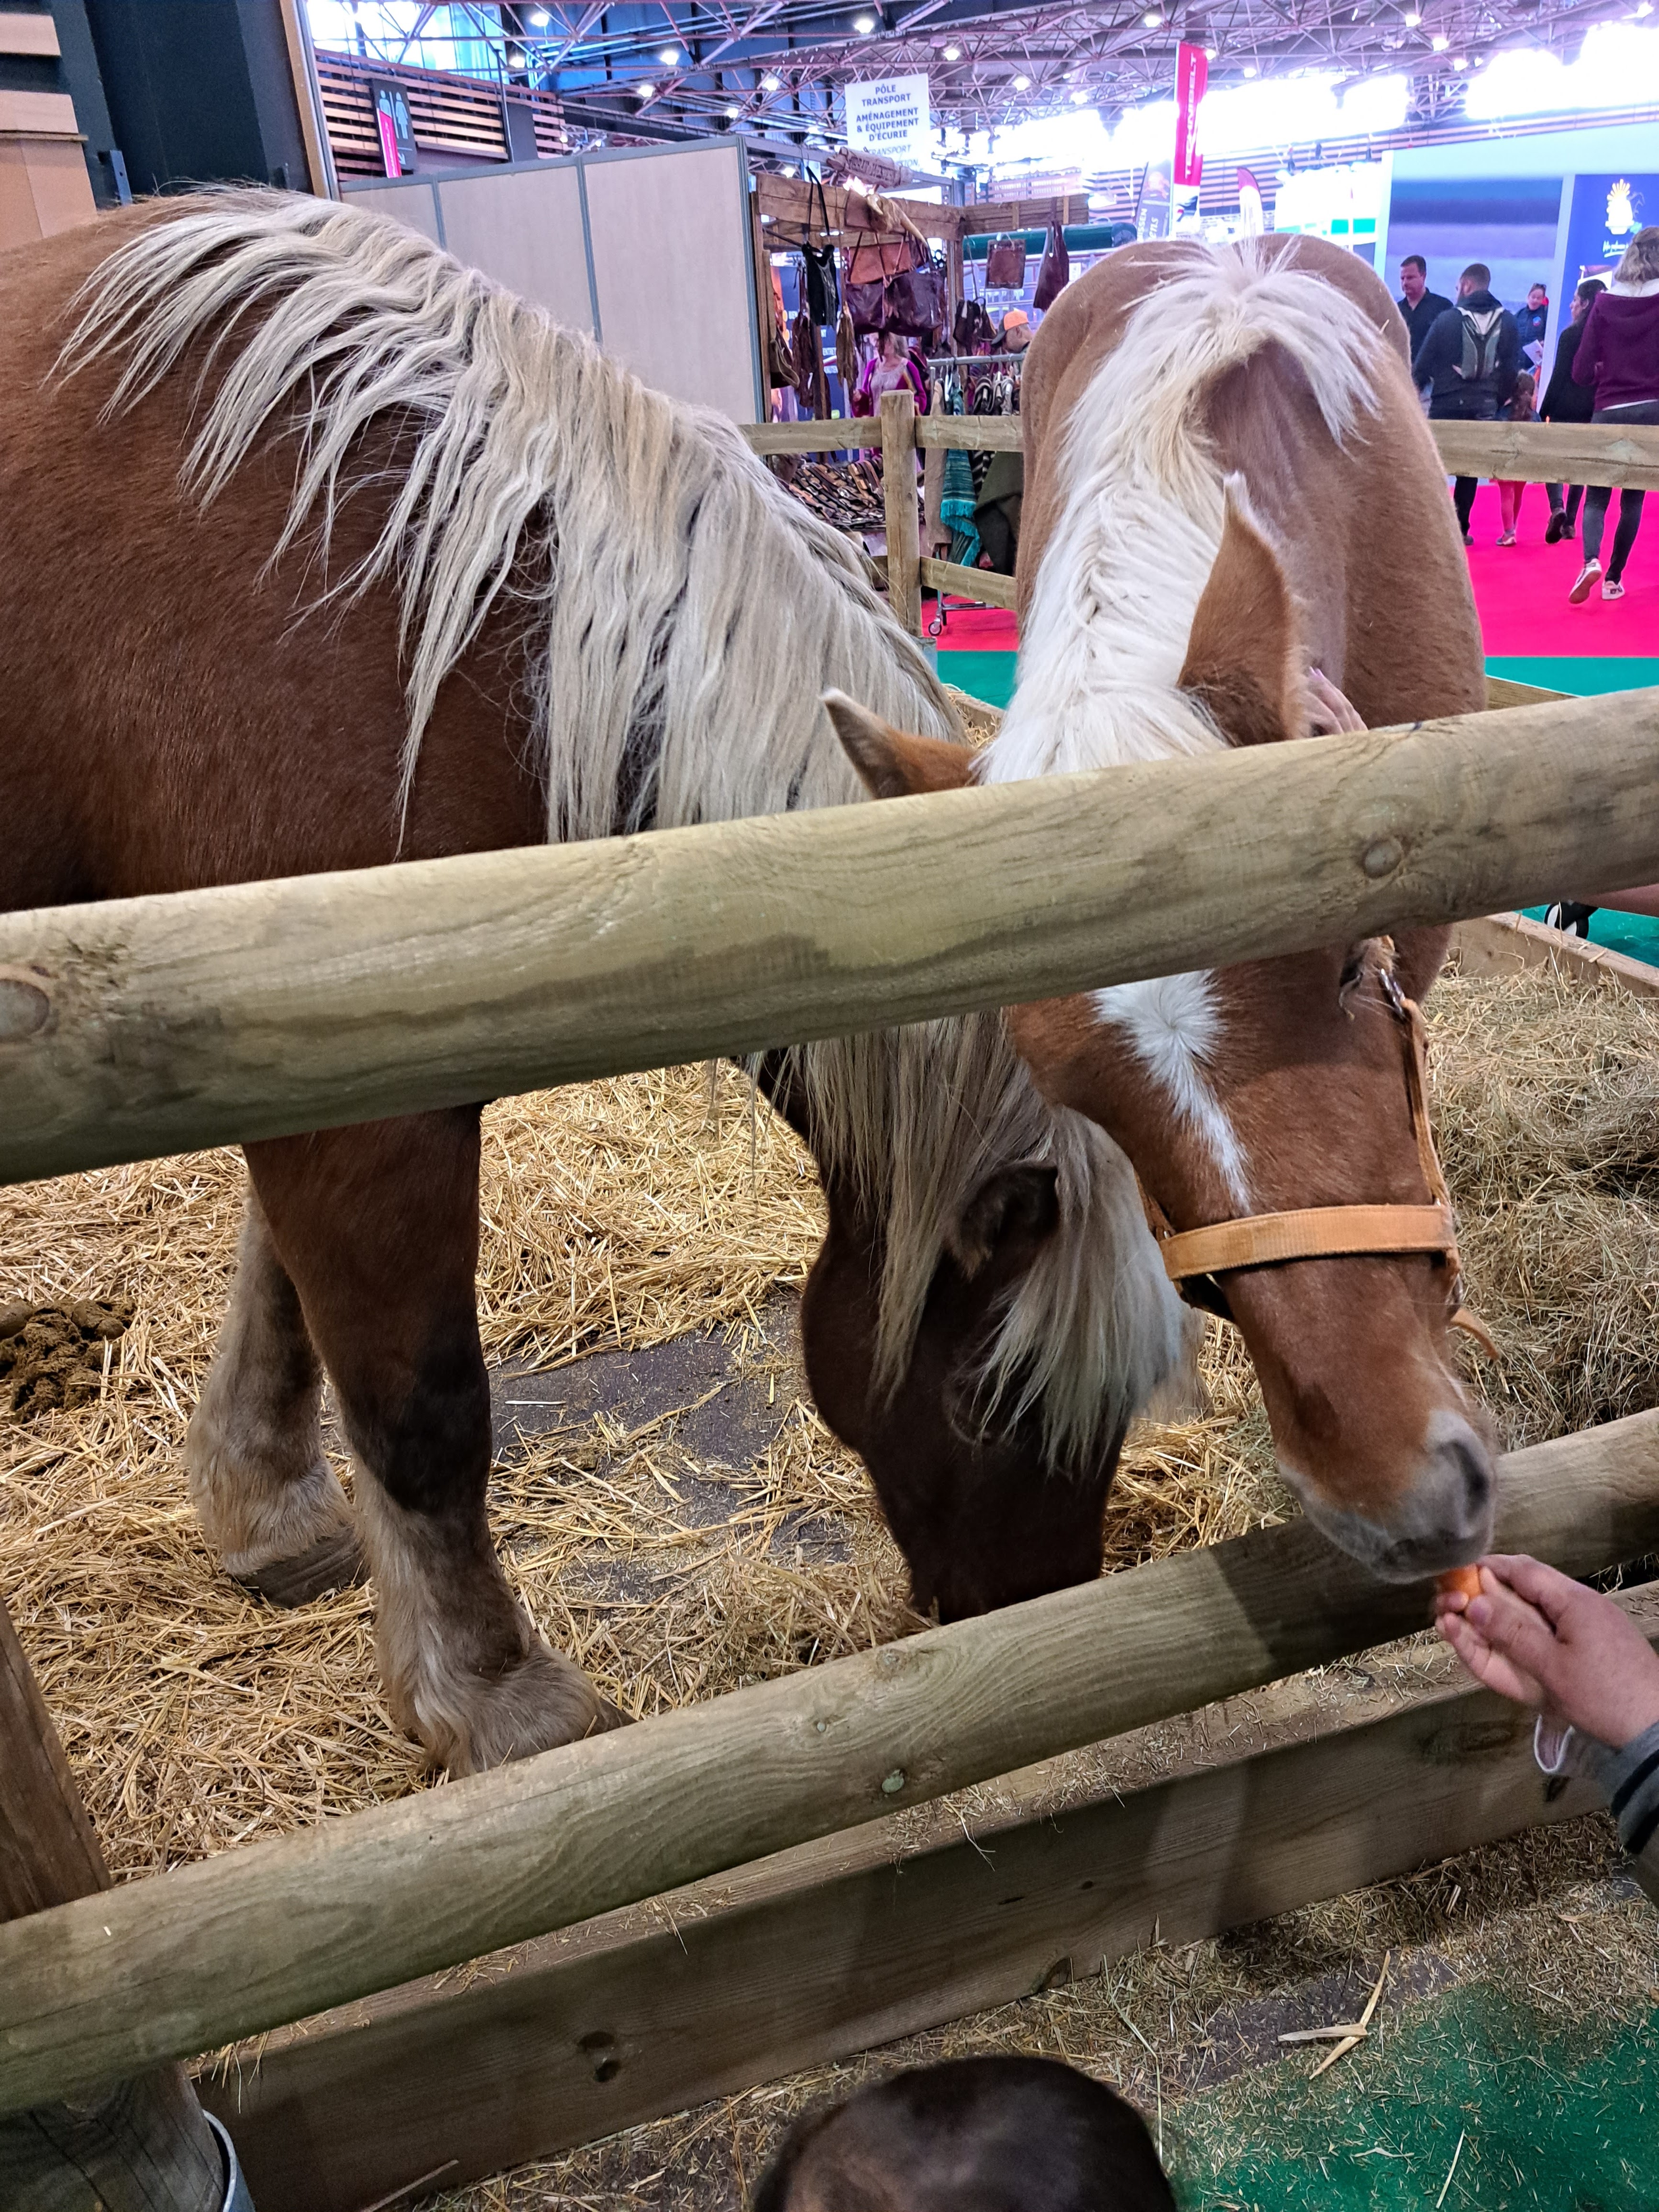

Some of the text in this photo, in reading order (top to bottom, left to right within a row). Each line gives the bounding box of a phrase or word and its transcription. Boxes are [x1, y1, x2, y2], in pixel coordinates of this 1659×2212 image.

[875, 84, 896, 95] PÔLE
[862, 93, 911, 107] TRANSPORT
[856, 107, 918, 122] AMÉNAGEMENT
[865, 118, 919, 133] ÉQUIPEMENT
[869, 130, 907, 142] D'ÉCURIE
